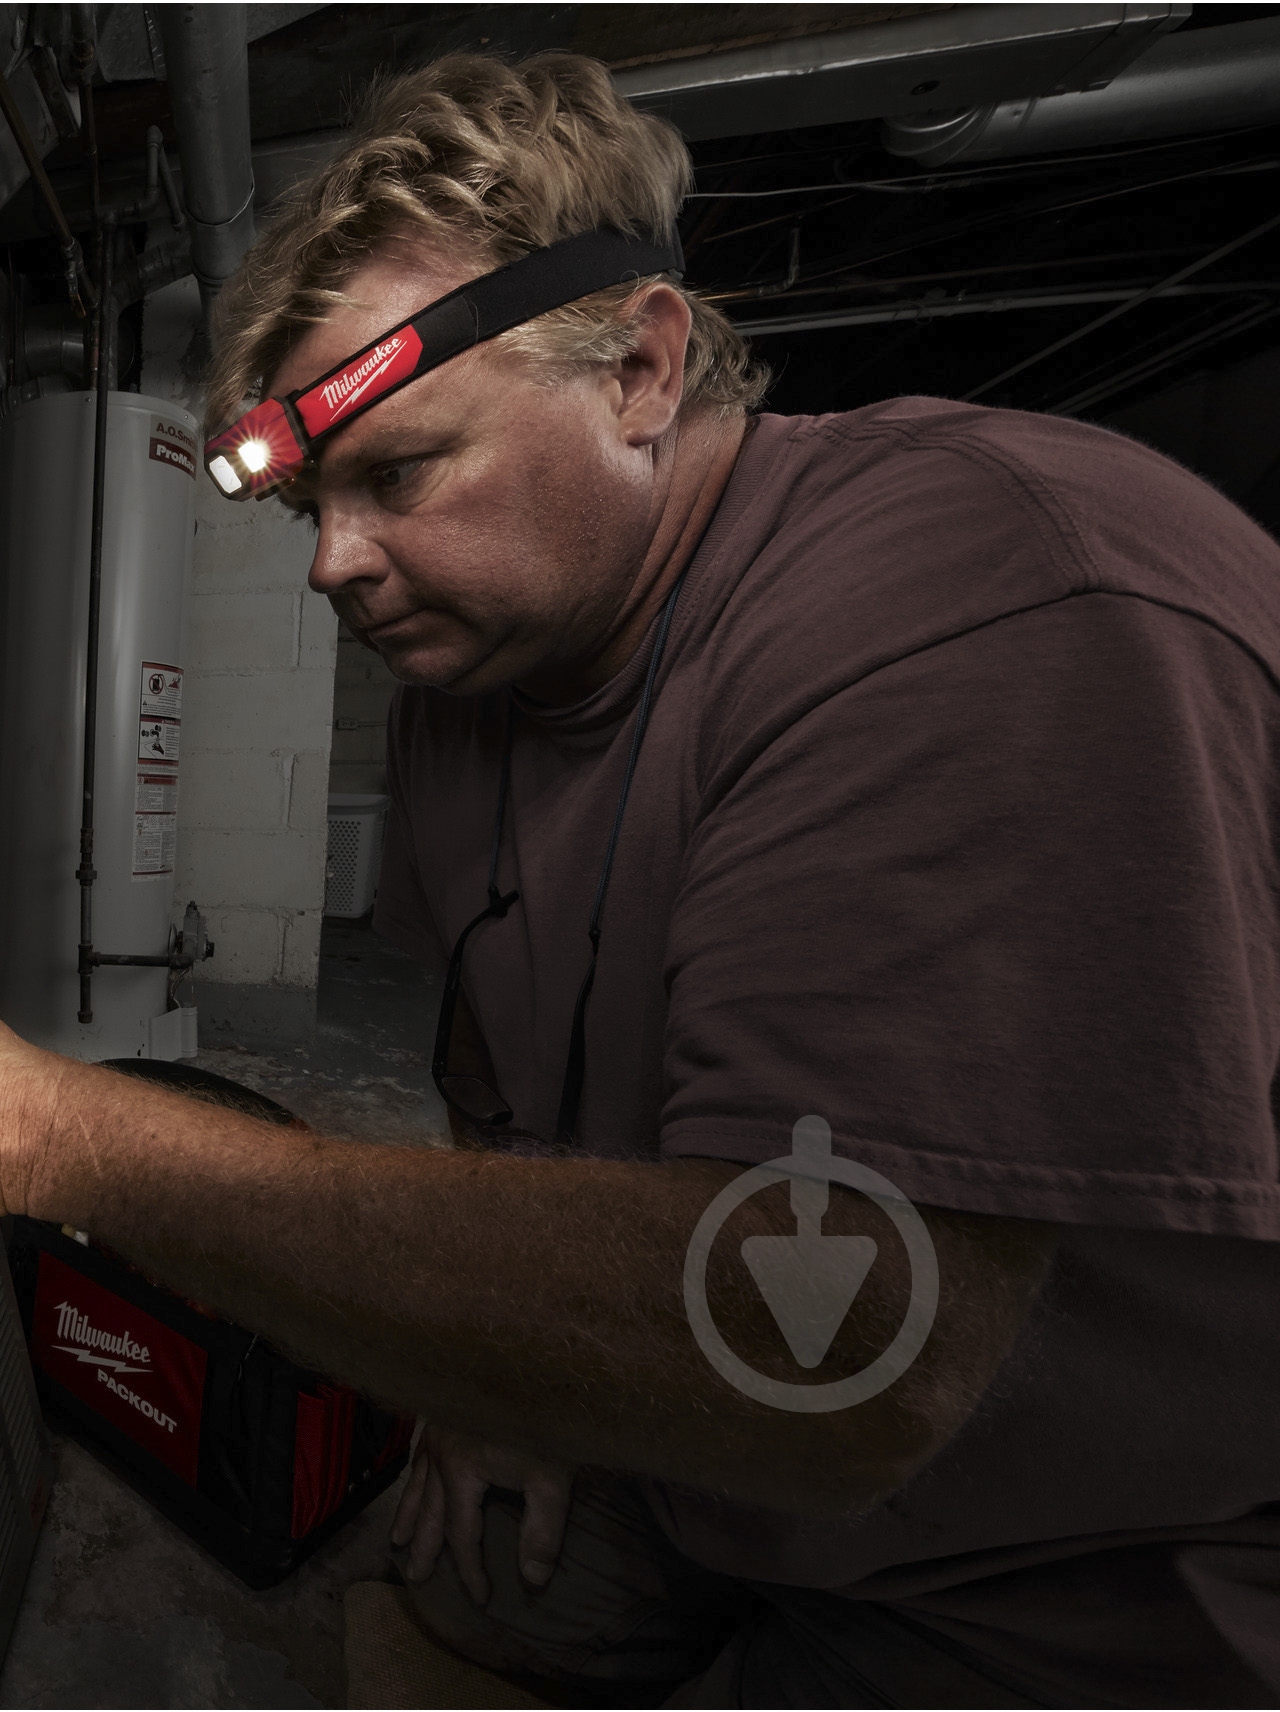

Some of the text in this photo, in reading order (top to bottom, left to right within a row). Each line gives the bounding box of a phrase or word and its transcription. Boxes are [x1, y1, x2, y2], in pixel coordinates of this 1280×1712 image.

[320, 337, 402, 409] Milwaukee
[156, 443, 195, 474] ProMax
[53, 1301, 151, 1364] Milwaukee
[97, 1369, 177, 1434] PACKOUT
